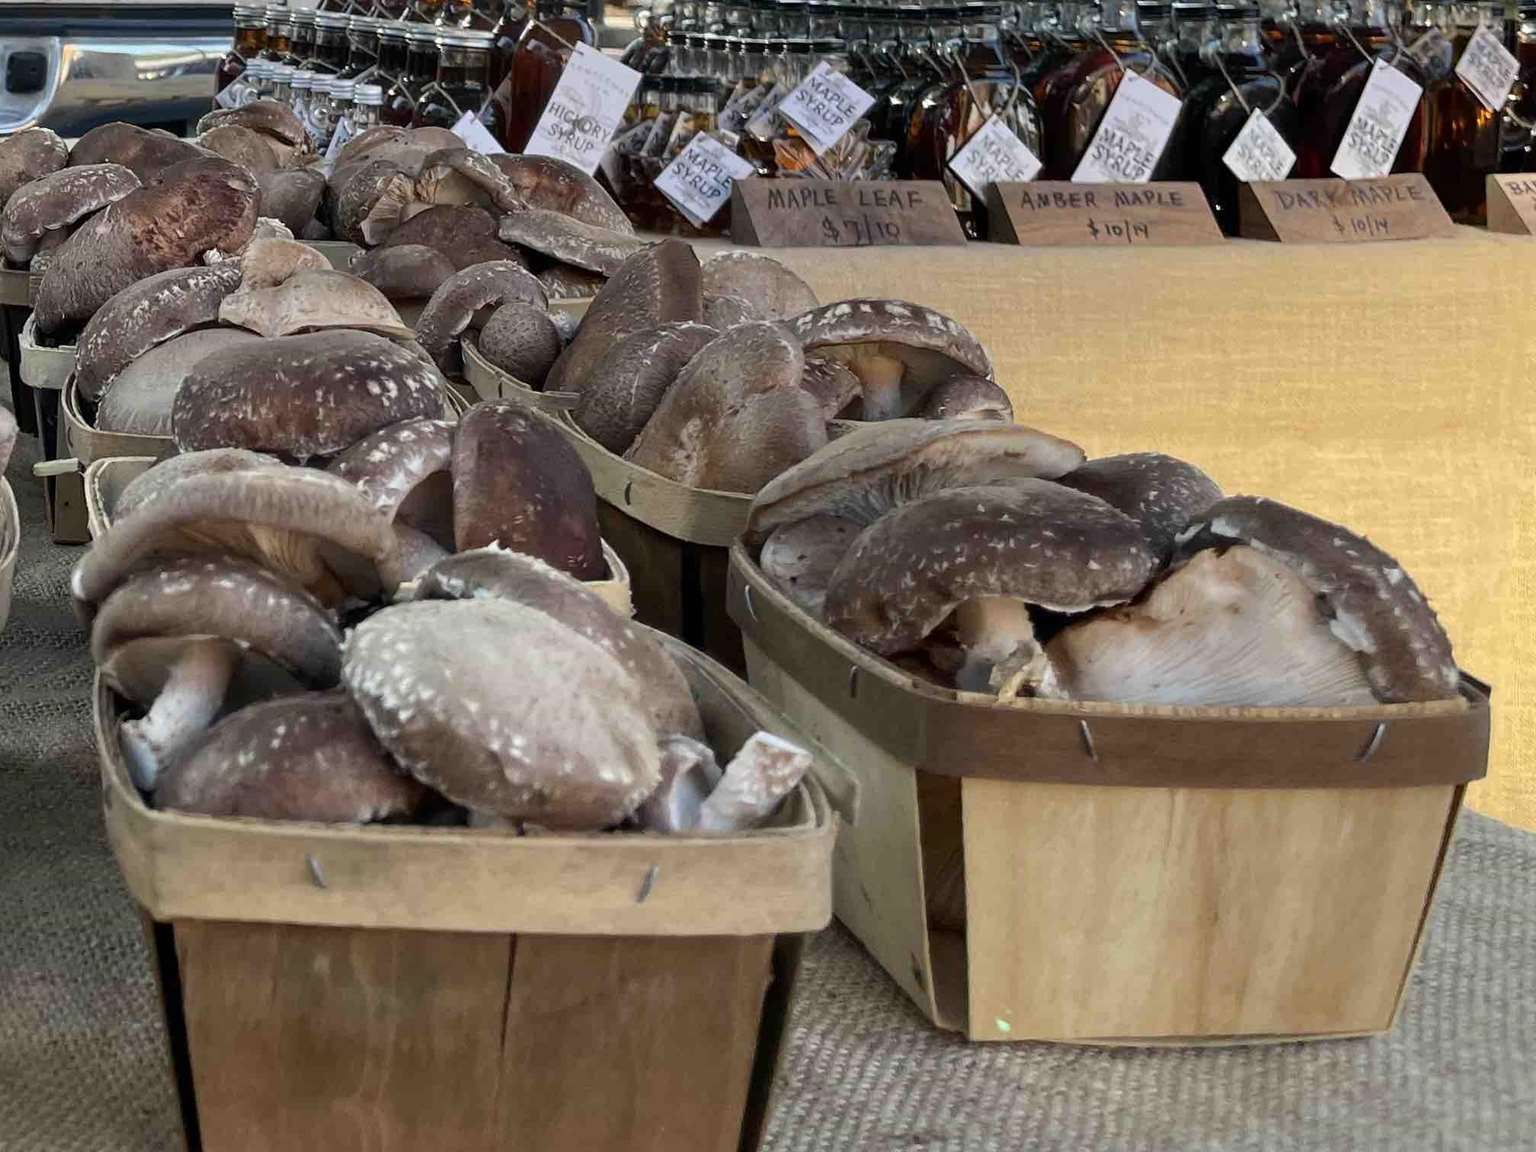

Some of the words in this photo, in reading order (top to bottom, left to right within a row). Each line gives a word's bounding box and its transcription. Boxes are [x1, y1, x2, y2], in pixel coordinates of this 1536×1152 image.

[795, 89, 844, 127] SYRUP
[809, 76, 857, 118] MAPLE
[547, 123, 594, 153] SYRUP
[548, 101, 612, 142] HICKORY
[671, 162, 722, 198] SYRUP
[684, 148, 733, 190] MAPLE
[768, 188, 837, 210] MAPLE
[859, 190, 924, 209] LEAF
[1020, 191, 1097, 212] AMBER
[1114, 190, 1185, 209] MAPLE
[1275, 188, 1337, 212] DARK
[1350, 184, 1427, 207] MAPLE
